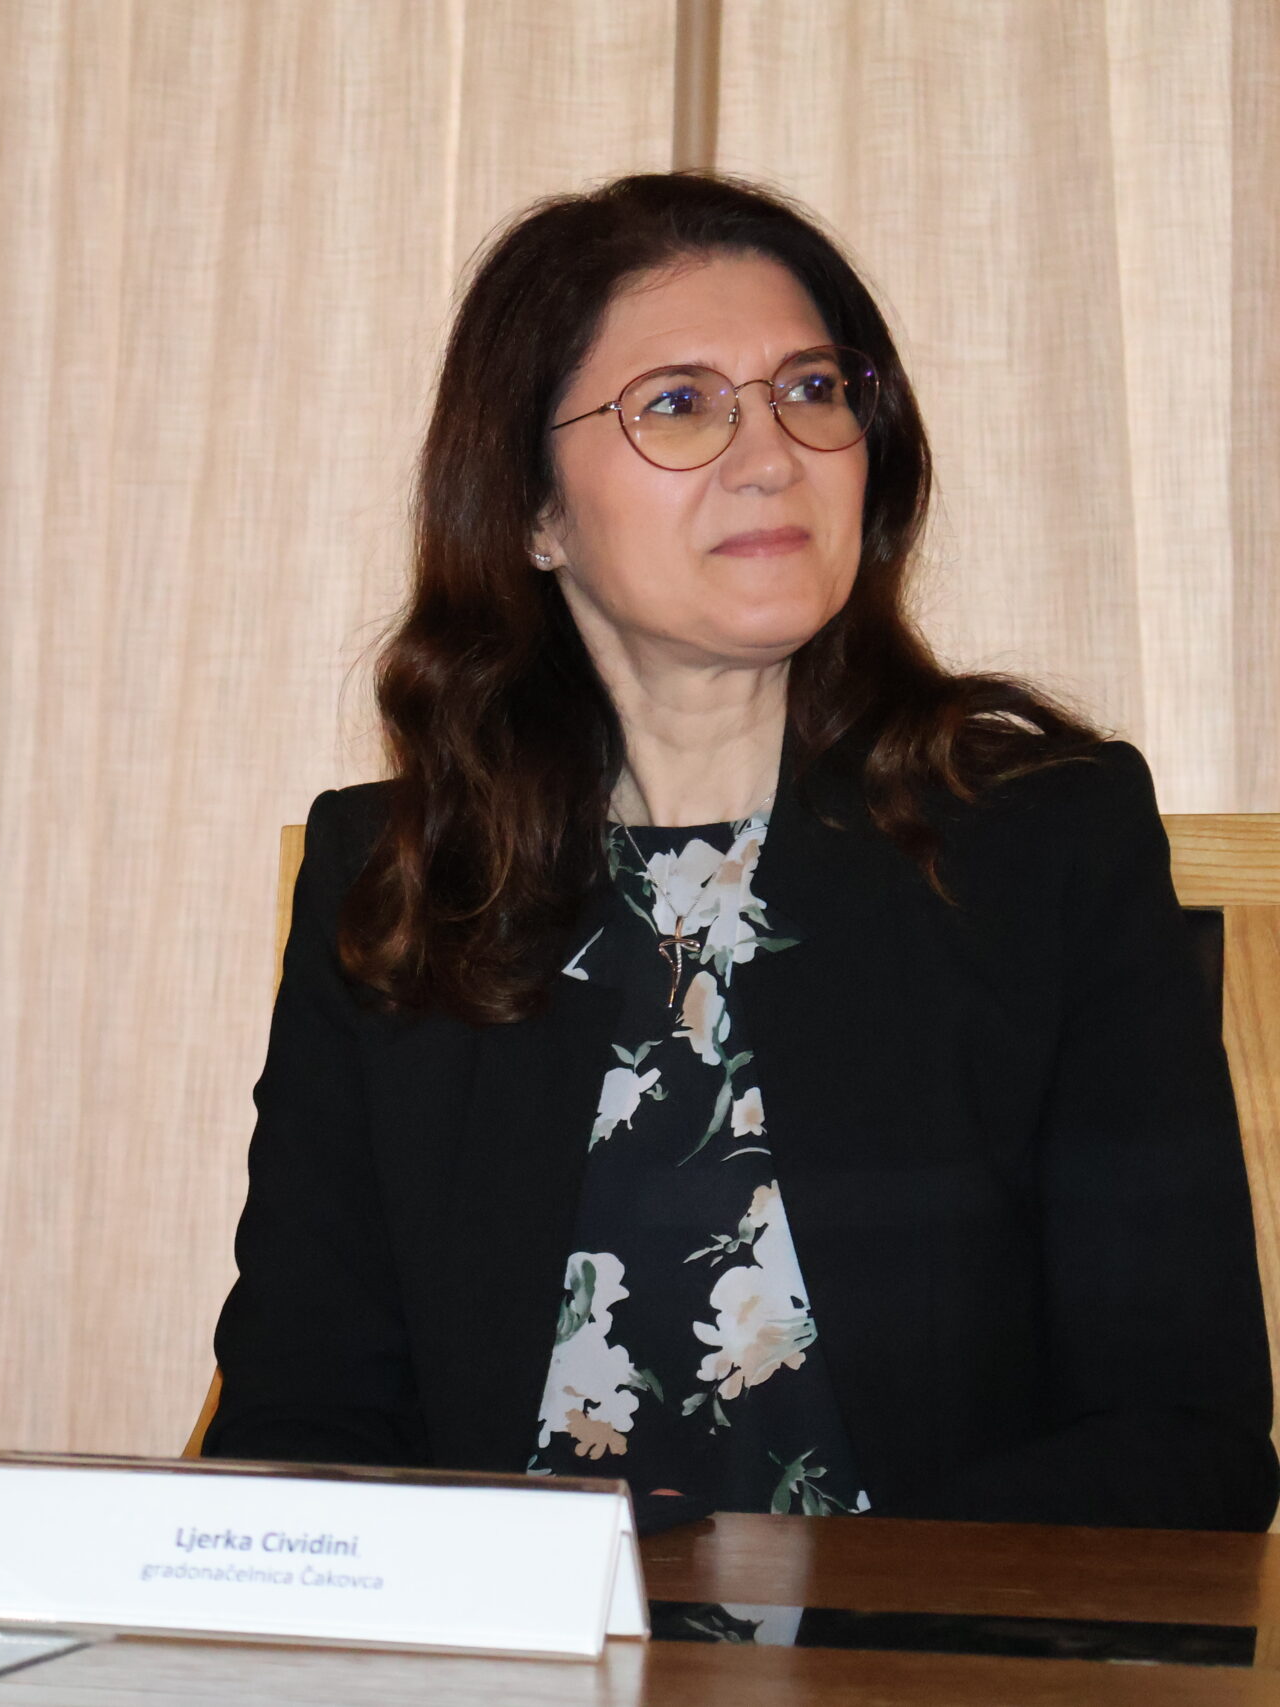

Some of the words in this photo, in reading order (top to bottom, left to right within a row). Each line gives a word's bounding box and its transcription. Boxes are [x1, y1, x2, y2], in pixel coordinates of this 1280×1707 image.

[175, 1527, 253, 1553] Ljerka
[260, 1531, 359, 1557] Cividini
[140, 1562, 294, 1586] gradonačelnica
[300, 1565, 385, 1590] Čakovca
